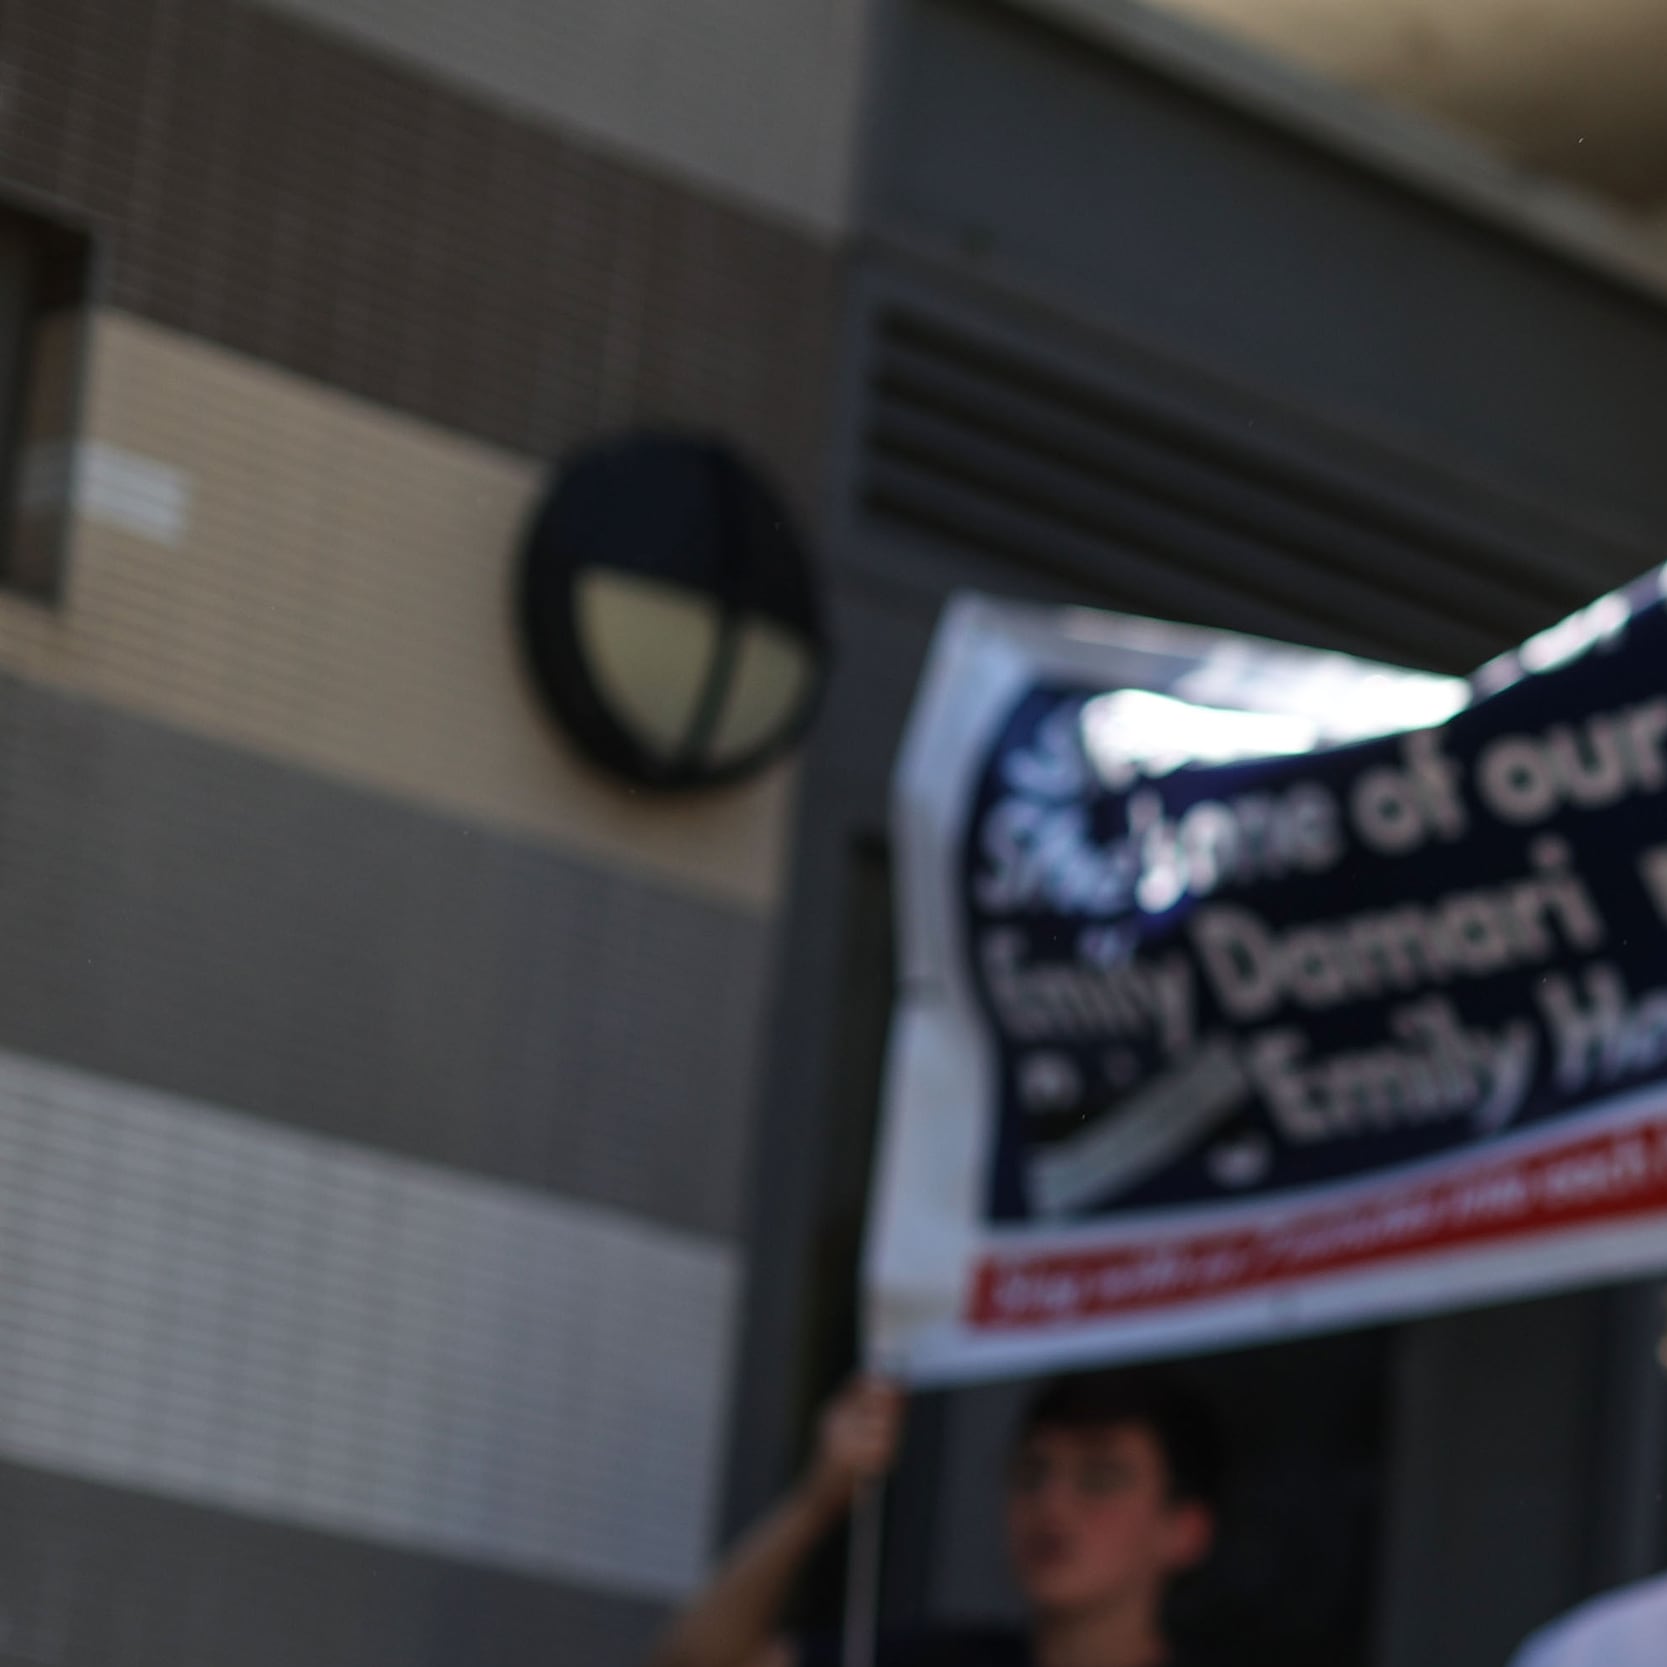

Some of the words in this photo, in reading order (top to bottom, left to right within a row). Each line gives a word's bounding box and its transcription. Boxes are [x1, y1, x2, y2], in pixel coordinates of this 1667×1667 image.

[1350, 728, 1468, 852] of
[1192, 832, 1602, 1020] Damari
[1258, 990, 1535, 1142] Emily
